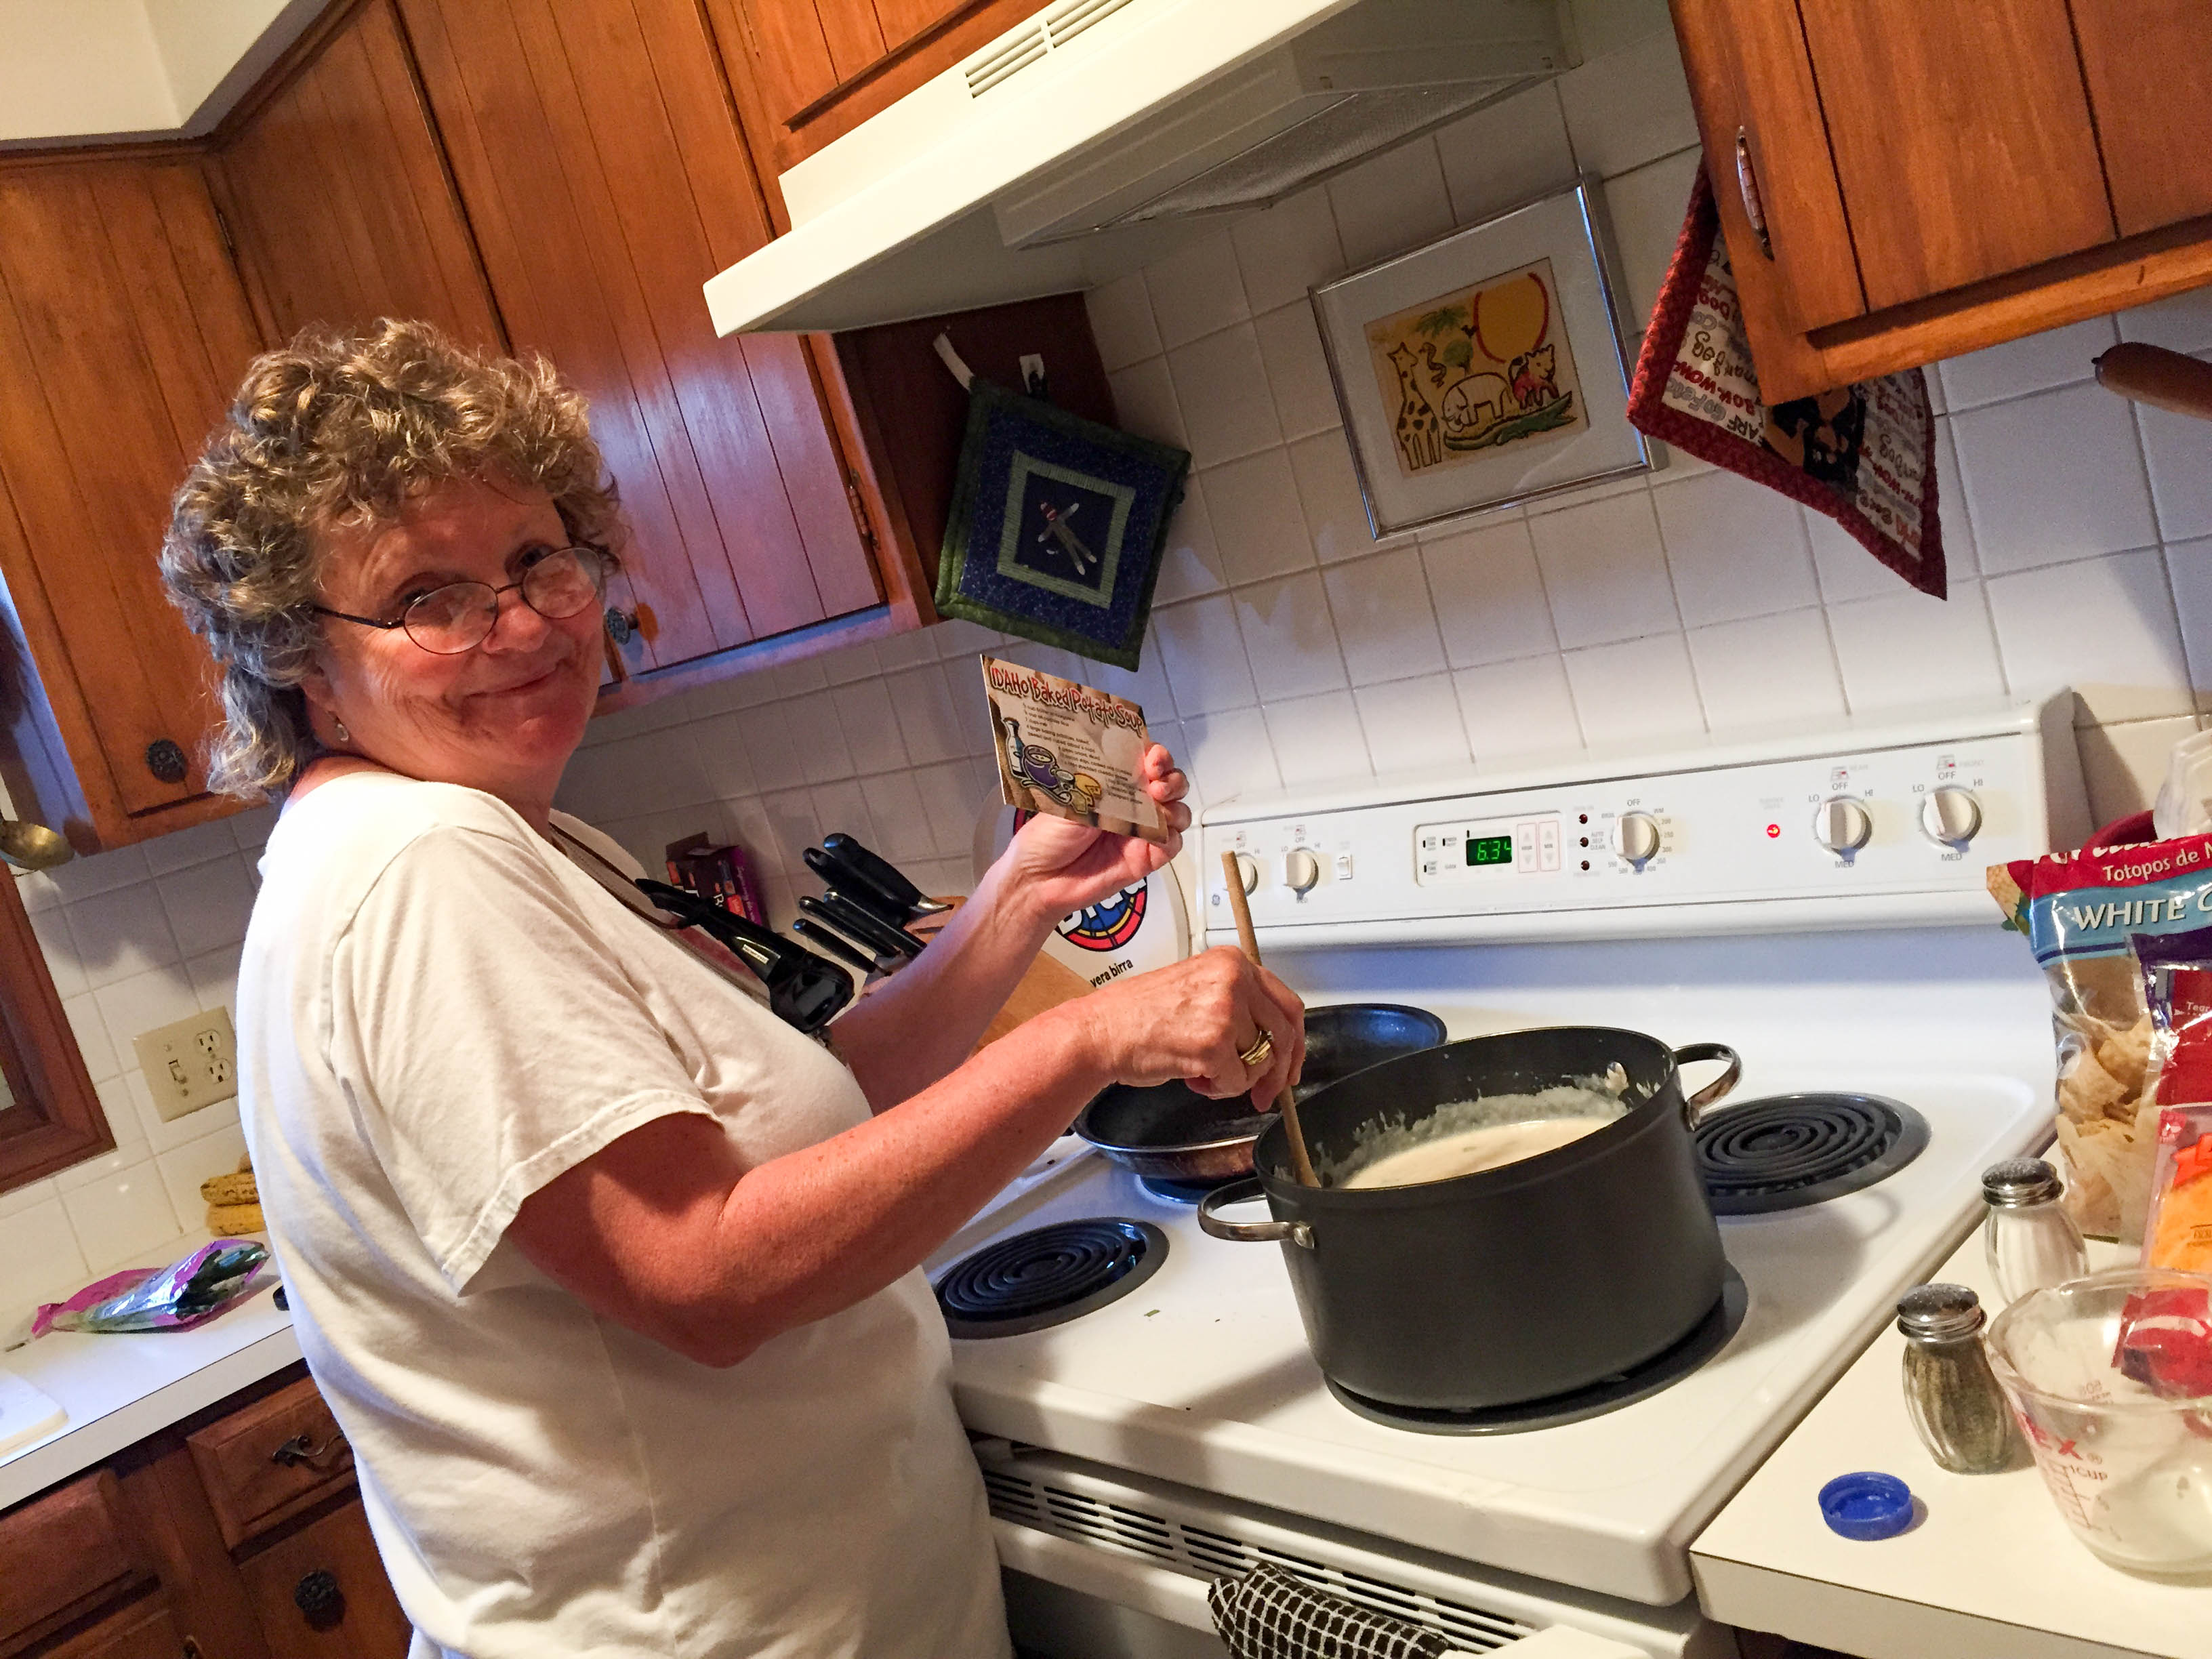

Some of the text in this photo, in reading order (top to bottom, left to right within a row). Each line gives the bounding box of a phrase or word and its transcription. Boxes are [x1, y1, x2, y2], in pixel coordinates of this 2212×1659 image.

[1030, 676, 1070, 708] Baked
[1938, 771, 1956, 780] OFF
[1832, 782, 1849, 791] OFF
[1973, 779, 1984, 787] HI
[1864, 789, 1873, 797] HI
[1912, 784, 1925, 793] LO
[1626, 798, 1641, 807] OFF
[1808, 794, 1820, 803] LO
[1940, 853, 1963, 862] MED
[1834, 859, 1855, 869] MED
[2103, 858, 2171, 882] Totopos
[2176, 848, 2201, 866] de
[2072, 898, 2186, 931] WHITE
[1090, 959, 1134, 988] vera birra
